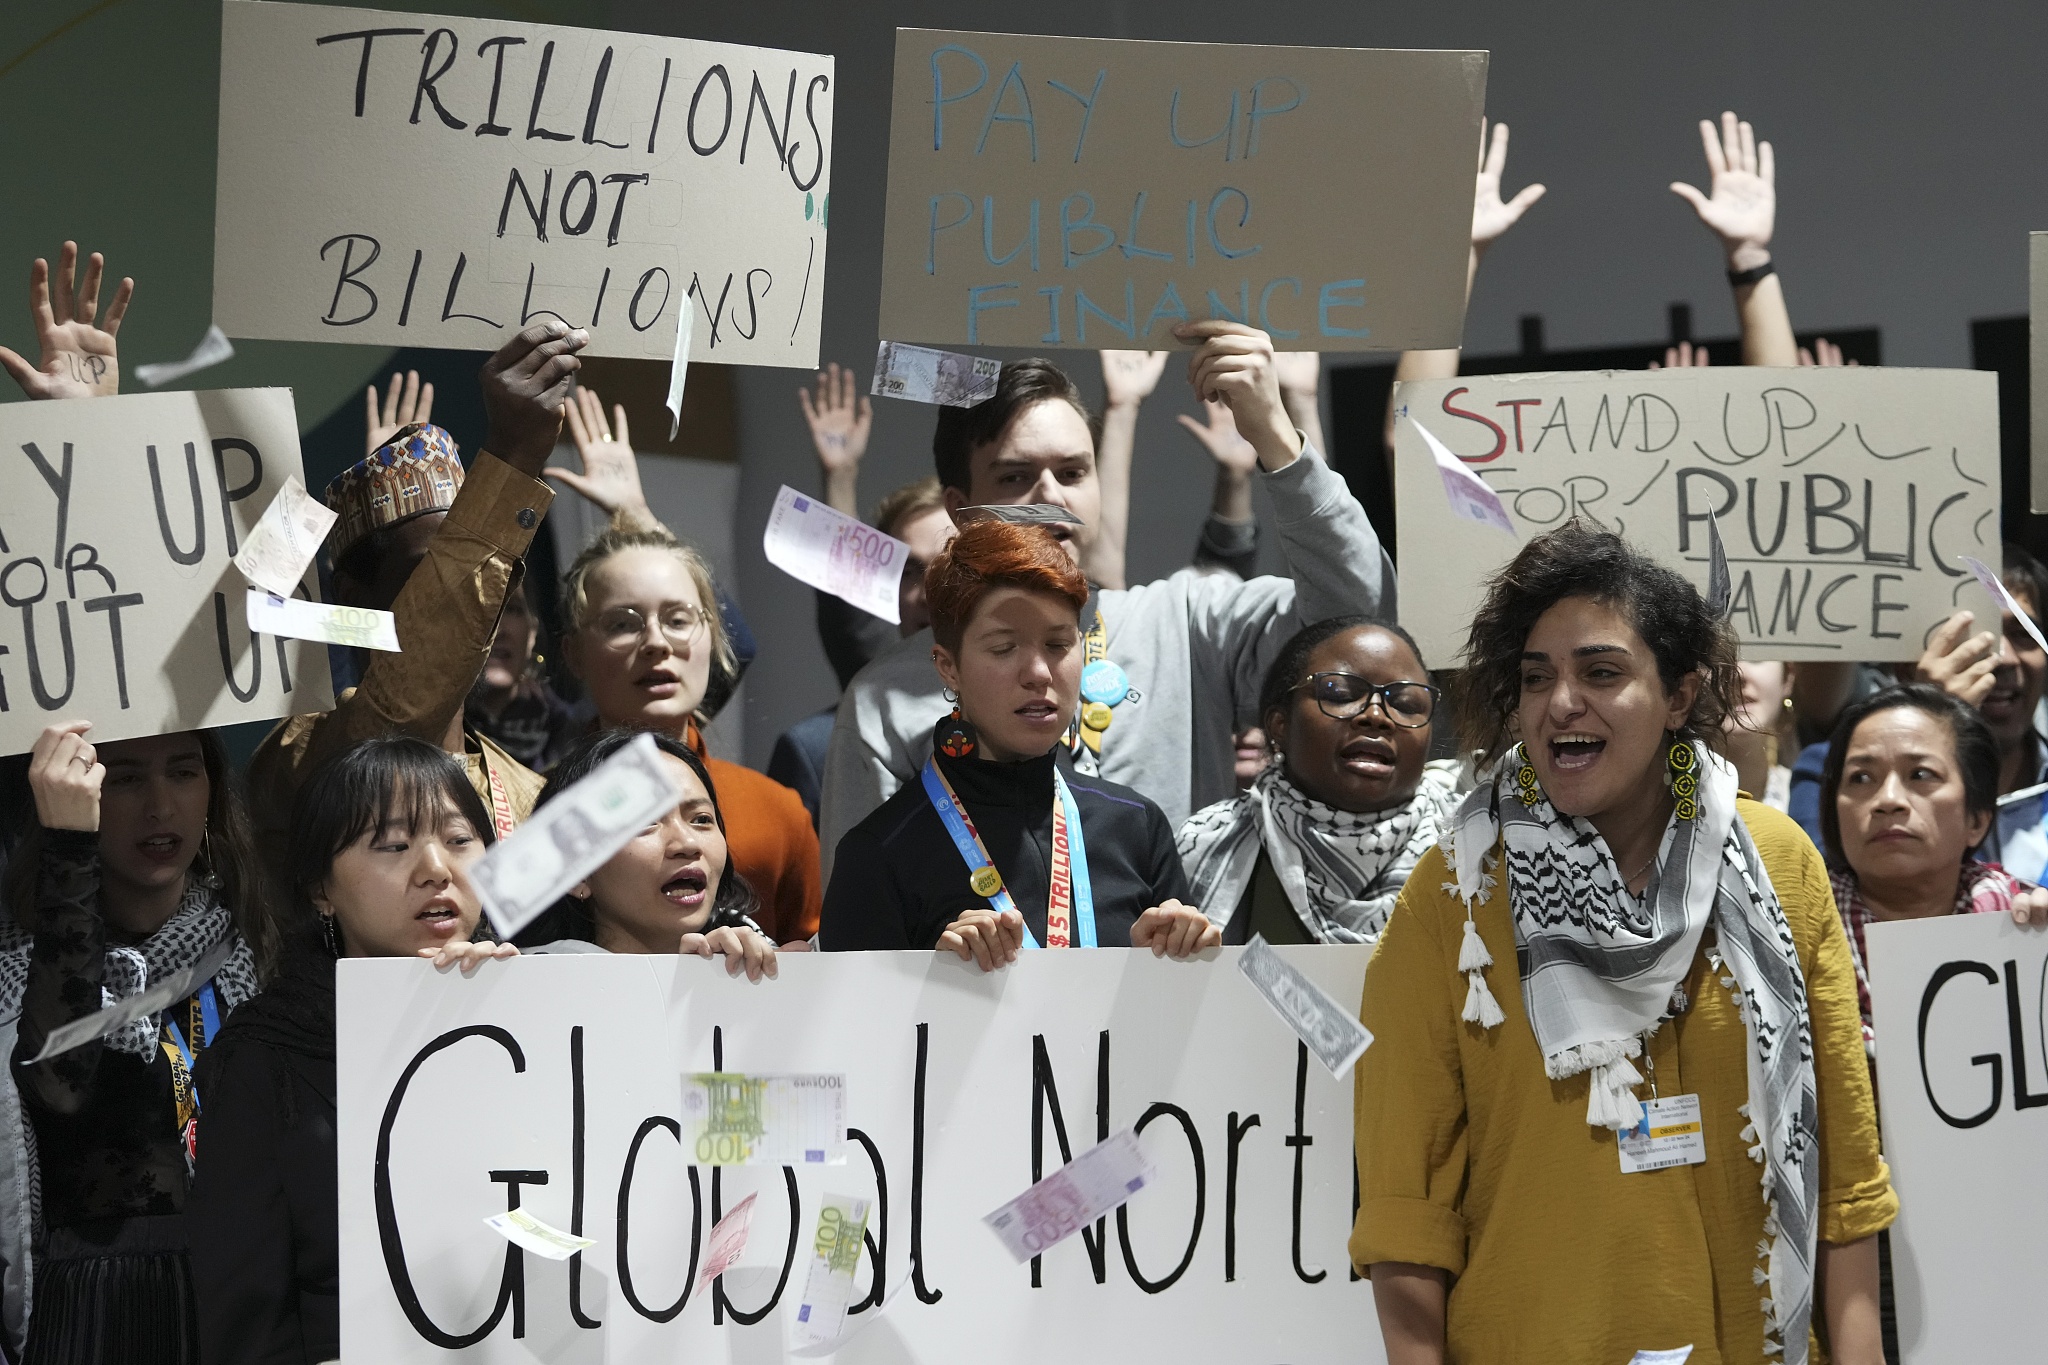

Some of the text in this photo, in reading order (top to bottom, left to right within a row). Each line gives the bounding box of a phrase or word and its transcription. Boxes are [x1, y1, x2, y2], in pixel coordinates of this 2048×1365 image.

[316, 27, 829, 192] TRILLIONS
[926, 45, 1306, 164] PAY UP
[497, 167, 650, 248] NOT
[926, 186, 1262, 276] PUBLIC
[967, 278, 1370, 345] FINANCE
[67, 353, 107, 385] UP
[888, 380, 905, 391] 200
[974, 360, 997, 376] 200
[1441, 387, 1817, 463] STAND UP
[145, 437, 264, 566] UP
[1676, 467, 1970, 577] PUBLIC
[0, 542, 117, 608] OR
[852, 525, 896, 567] 500
[336, 608, 380, 628] 100
[1727, 568, 1909, 639] ANCE
[1049, 915, 1068, 932] 5
[1917, 957, 2048, 1130] GL
[172, 1060, 185, 1102] GLOBAL
[695, 1133, 747, 1163] 100
[1660, 1124, 1691, 1135] OBSERVER
[373, 1022, 1361, 1350] Global Nort
[815, 1206, 841, 1254] 100
